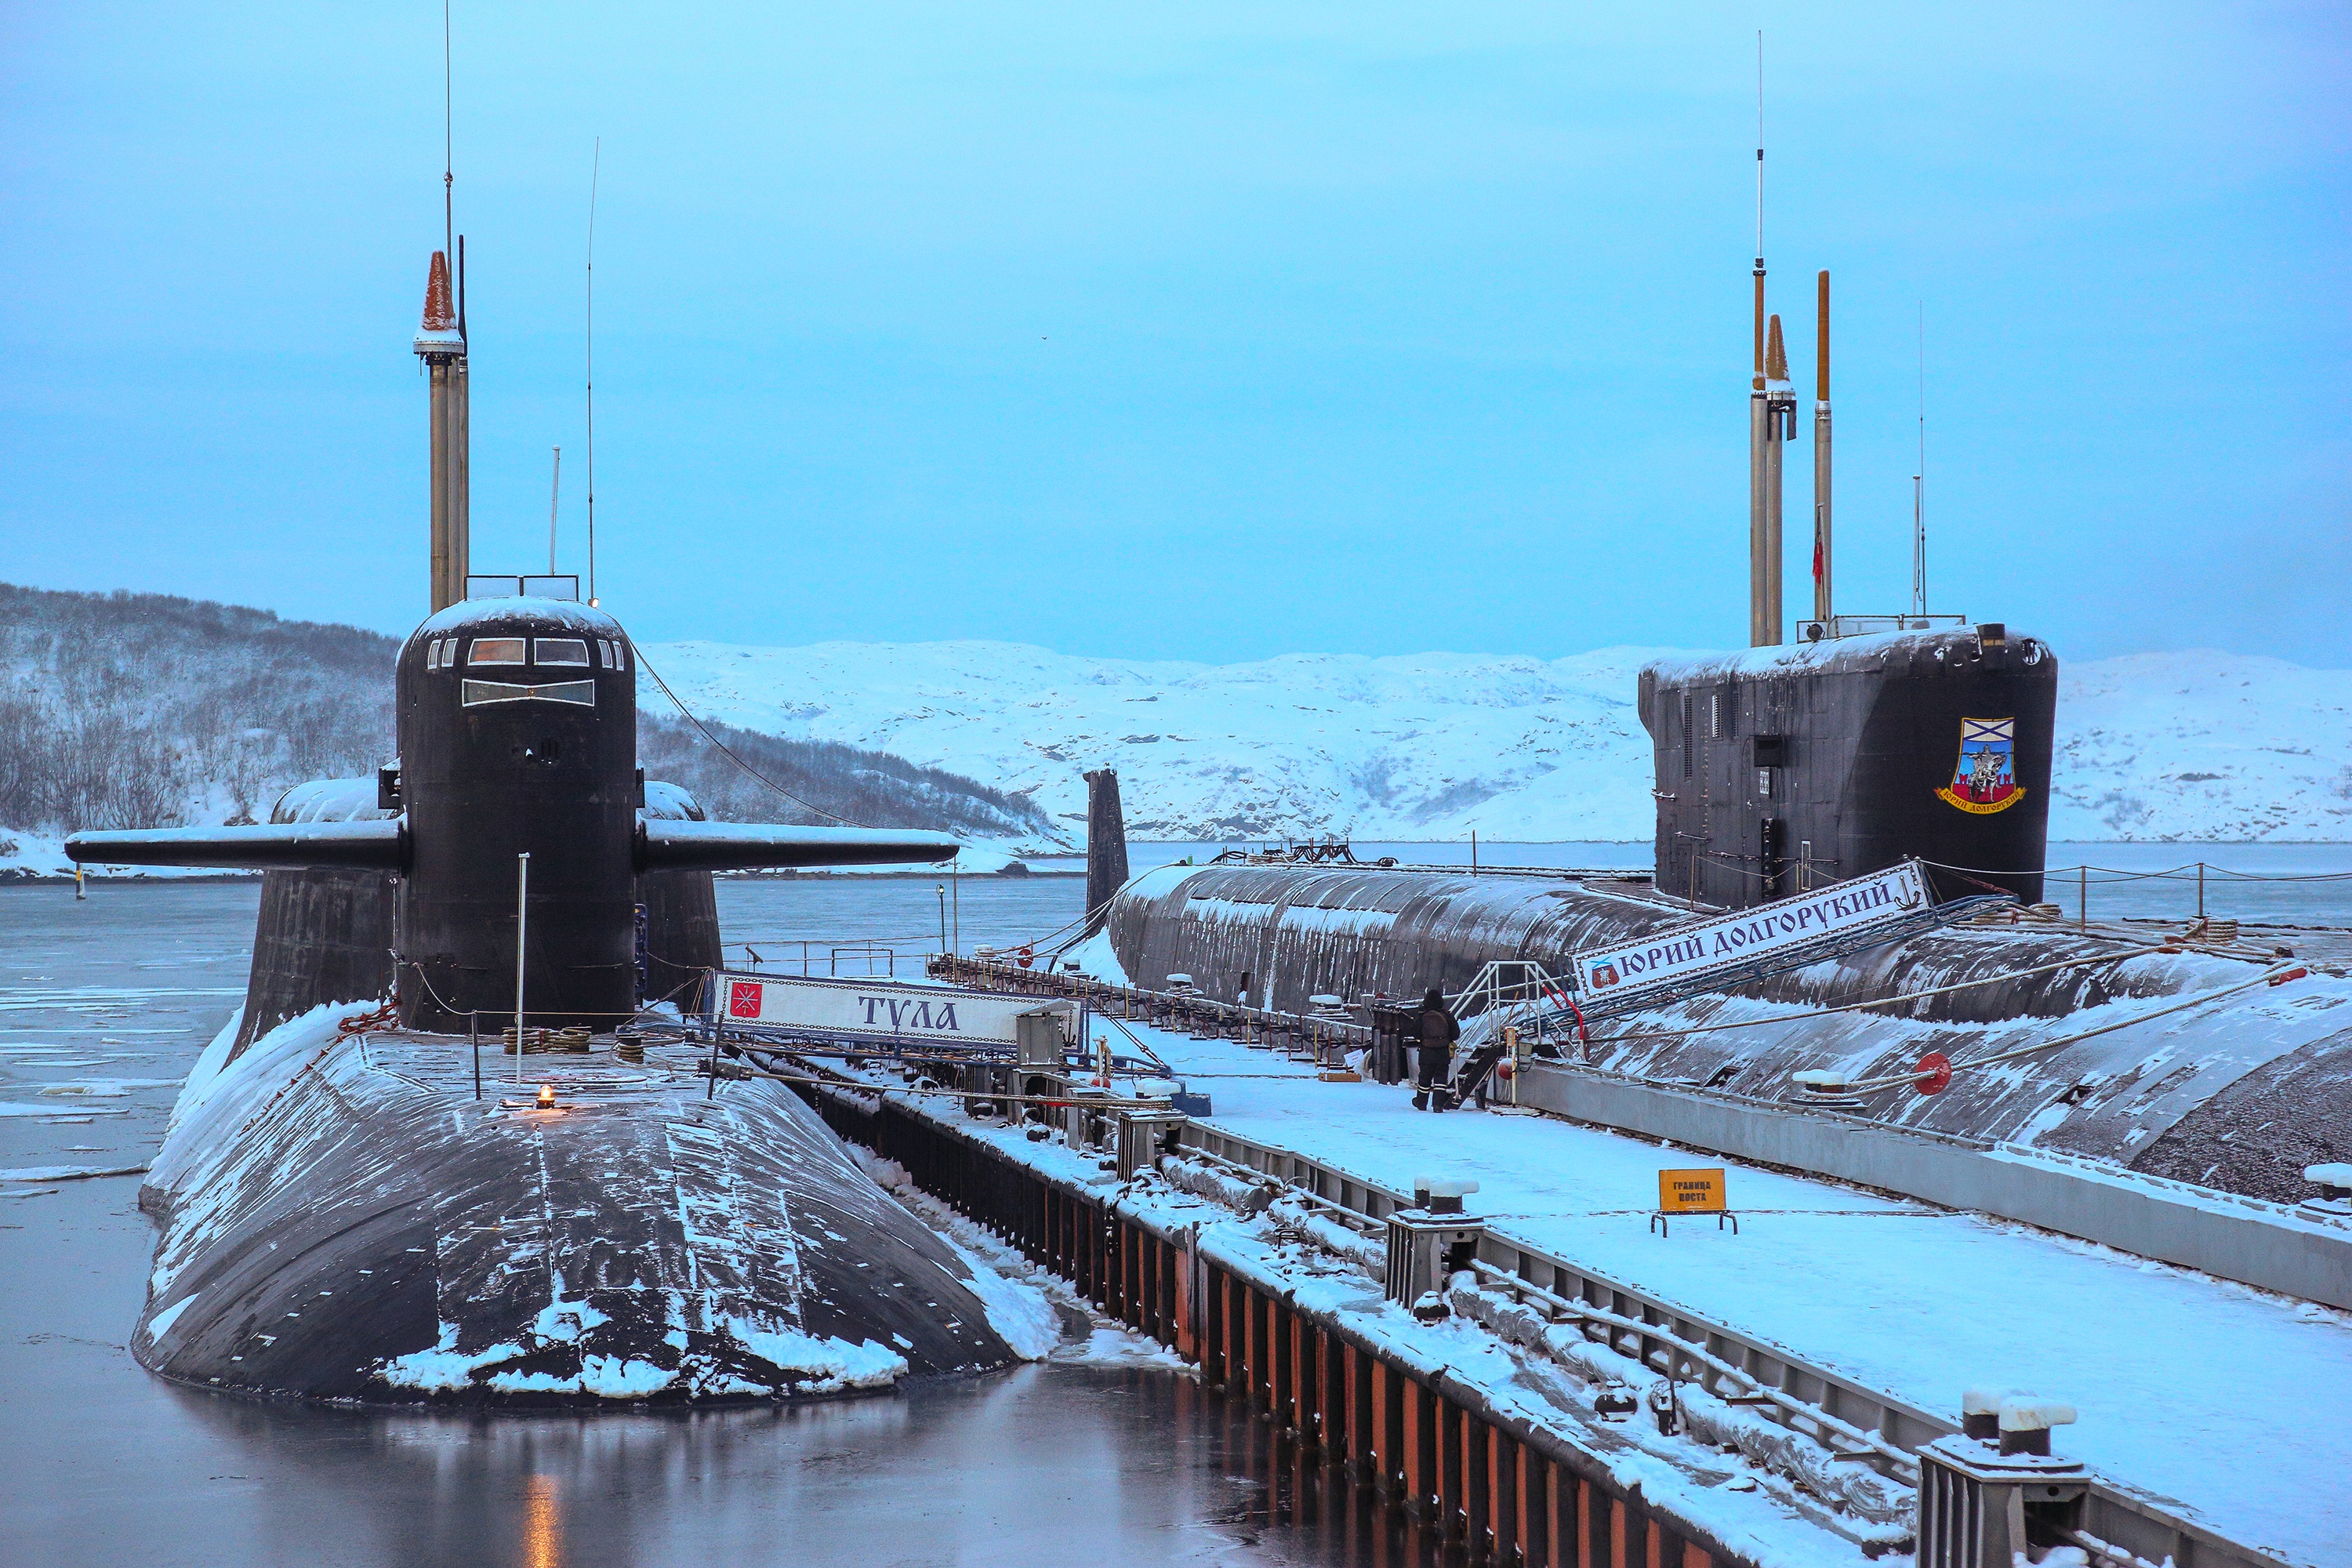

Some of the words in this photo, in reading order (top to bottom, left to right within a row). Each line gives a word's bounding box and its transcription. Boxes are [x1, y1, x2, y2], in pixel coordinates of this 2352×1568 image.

[1619, 933, 1706, 977] ЮРИЙ
[1713, 880, 1893, 957] ДОЛГОРУКИЙ
[858, 996, 960, 1034] ТУЛА
[1673, 1181, 1711, 1190] ГРАНИЦА
